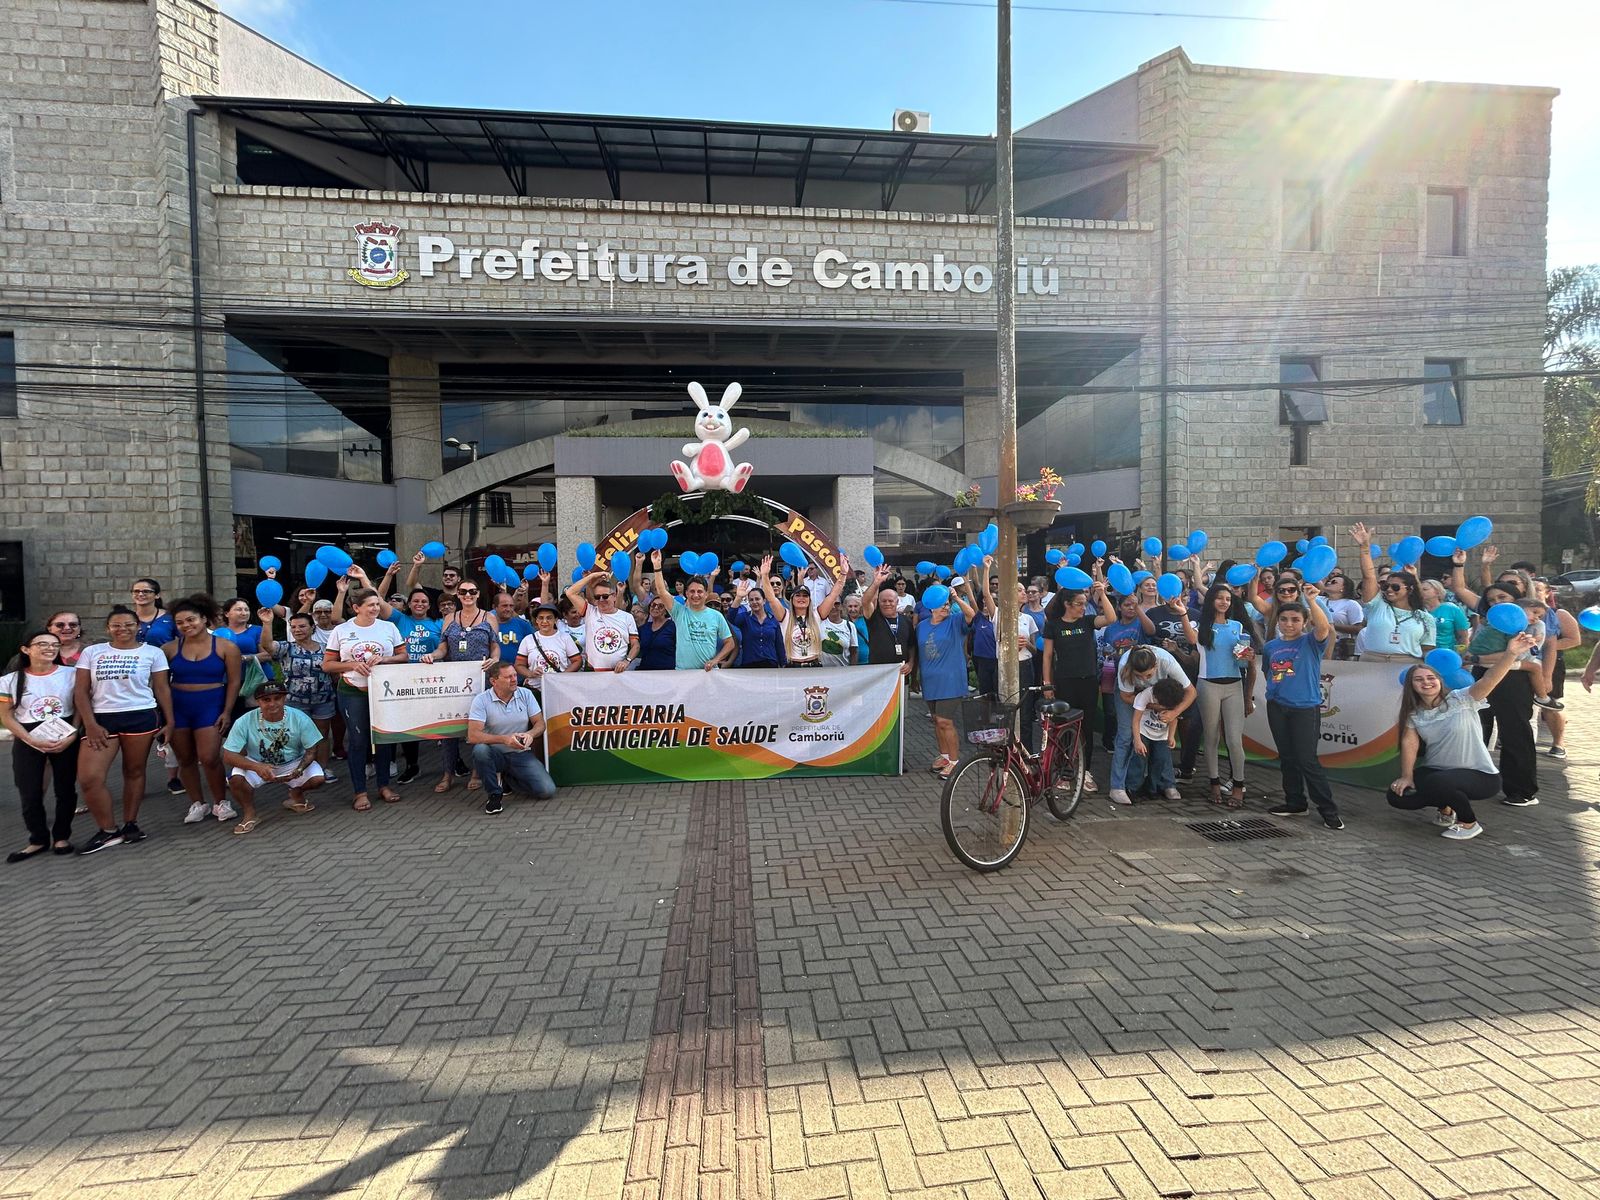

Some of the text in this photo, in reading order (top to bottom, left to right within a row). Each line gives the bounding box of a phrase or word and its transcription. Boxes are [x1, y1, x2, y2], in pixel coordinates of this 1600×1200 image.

[418, 236, 709, 285] Prefeitura
[727, 247, 793, 286] de
[812, 249, 1060, 296] Camboiú
[594, 527, 639, 571] Feliz
[410, 645, 427, 653] SUS
[396, 688, 415, 697] ABRIL
[416, 686, 438, 695] VERDE
[438, 686, 443, 695] E
[444, 685, 460, 694] AZUL
[570, 703, 686, 727] SECRETARIA
[571, 720, 779, 751] MUNICIPAL DE SAÚDE
[788, 731, 845, 742] Camboriú
[1338, 723, 1353, 732] DE
